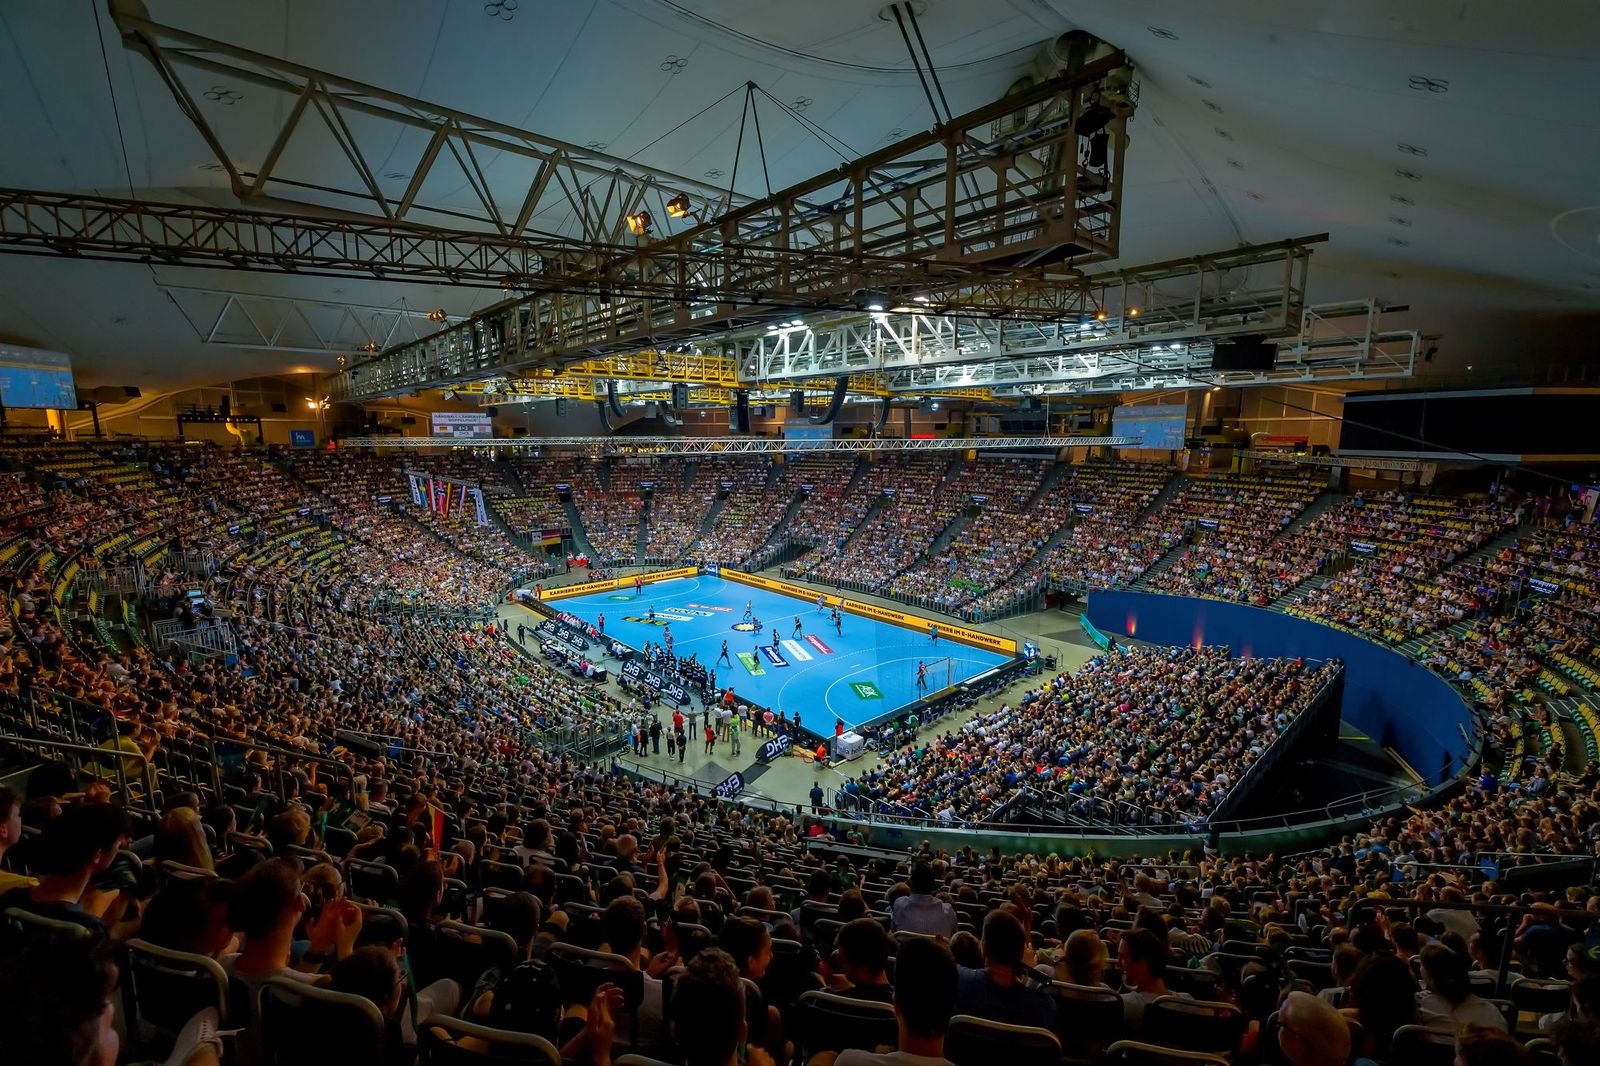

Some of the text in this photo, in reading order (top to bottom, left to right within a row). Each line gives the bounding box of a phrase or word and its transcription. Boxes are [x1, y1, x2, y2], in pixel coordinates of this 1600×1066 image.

[549, 588, 575, 596] KARRIERE
[582, 582, 614, 591] E-HANDWERK
[846, 601, 866, 611] KARRIERE
[873, 609, 904, 620] E-HANDWERK
[961, 632, 1001, 645] E-HANDWERK
[623, 662, 640, 677] DHB
[644, 673, 661, 688] DHB
[667, 684, 684, 700] DHB
